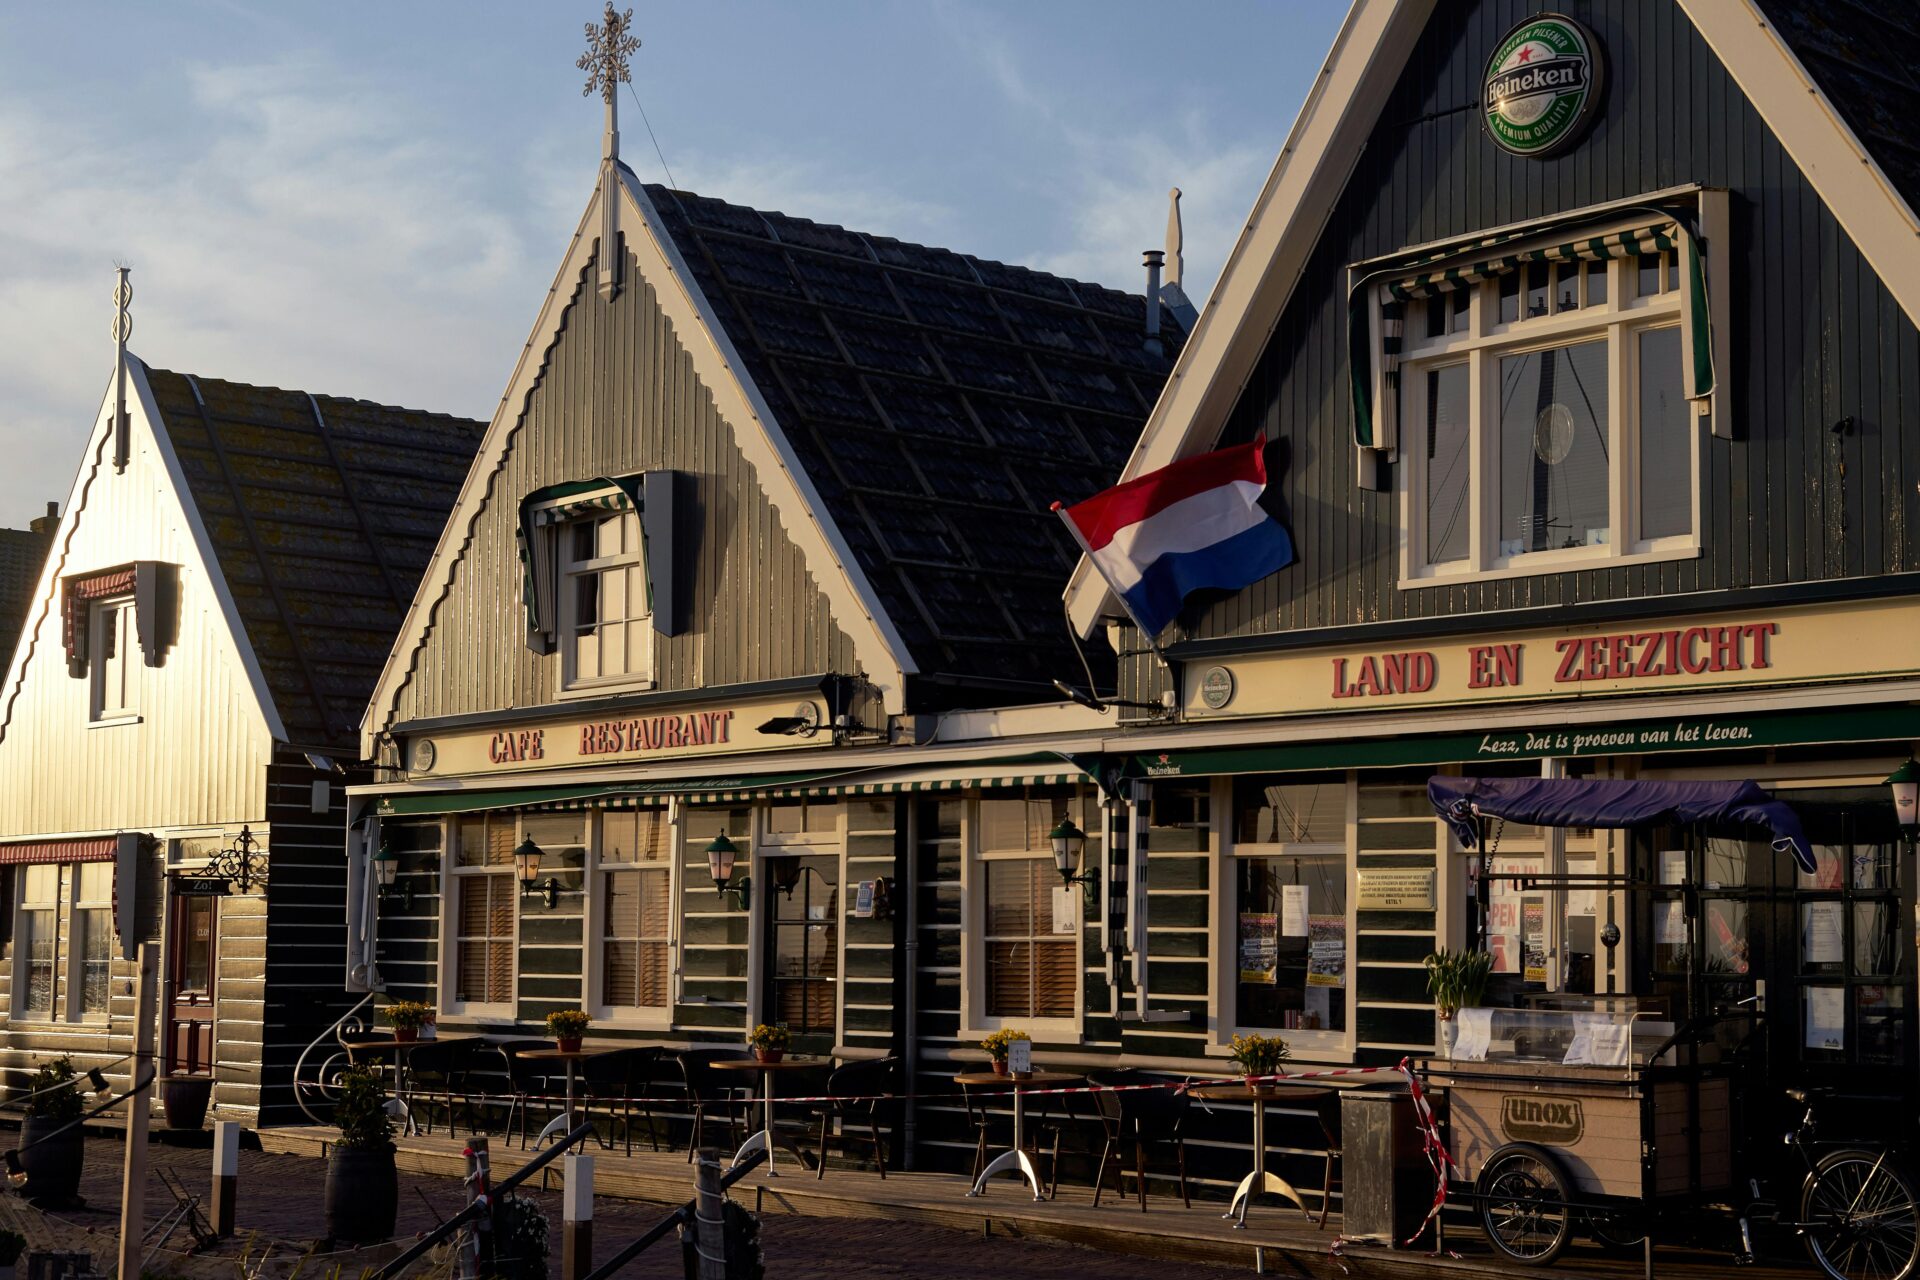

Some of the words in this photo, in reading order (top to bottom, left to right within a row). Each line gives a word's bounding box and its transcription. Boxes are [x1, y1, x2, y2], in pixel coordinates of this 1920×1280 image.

[1495, 31, 1532, 67] HEINEKEN
[1532, 28, 1569, 50] PILSENER
[1488, 67, 1575, 103] Heineken
[1494, 116, 1532, 140] PREMIUM
[1534, 100, 1569, 137] QUALITY
[1332, 651, 1435, 699] LAND
[1468, 643, 1521, 689] EN
[1554, 622, 1776, 683] ZEEZICHT
[488, 730, 543, 763] CAFE
[578, 710, 734, 756] RESTAURANT
[1525, 734, 1551, 752] dat
[1555, 736, 1568, 750] is
[1572, 731, 1635, 756] proeven
[1640, 730, 1669, 743] van
[1674, 722, 1700, 741] het
[1704, 723, 1753, 740] leven.
[1147, 765, 1181, 776] Heineken
[194, 880, 212, 890] Zo!
[197, 928, 210, 936] CLO
[1488, 903, 1516, 927] PEN
